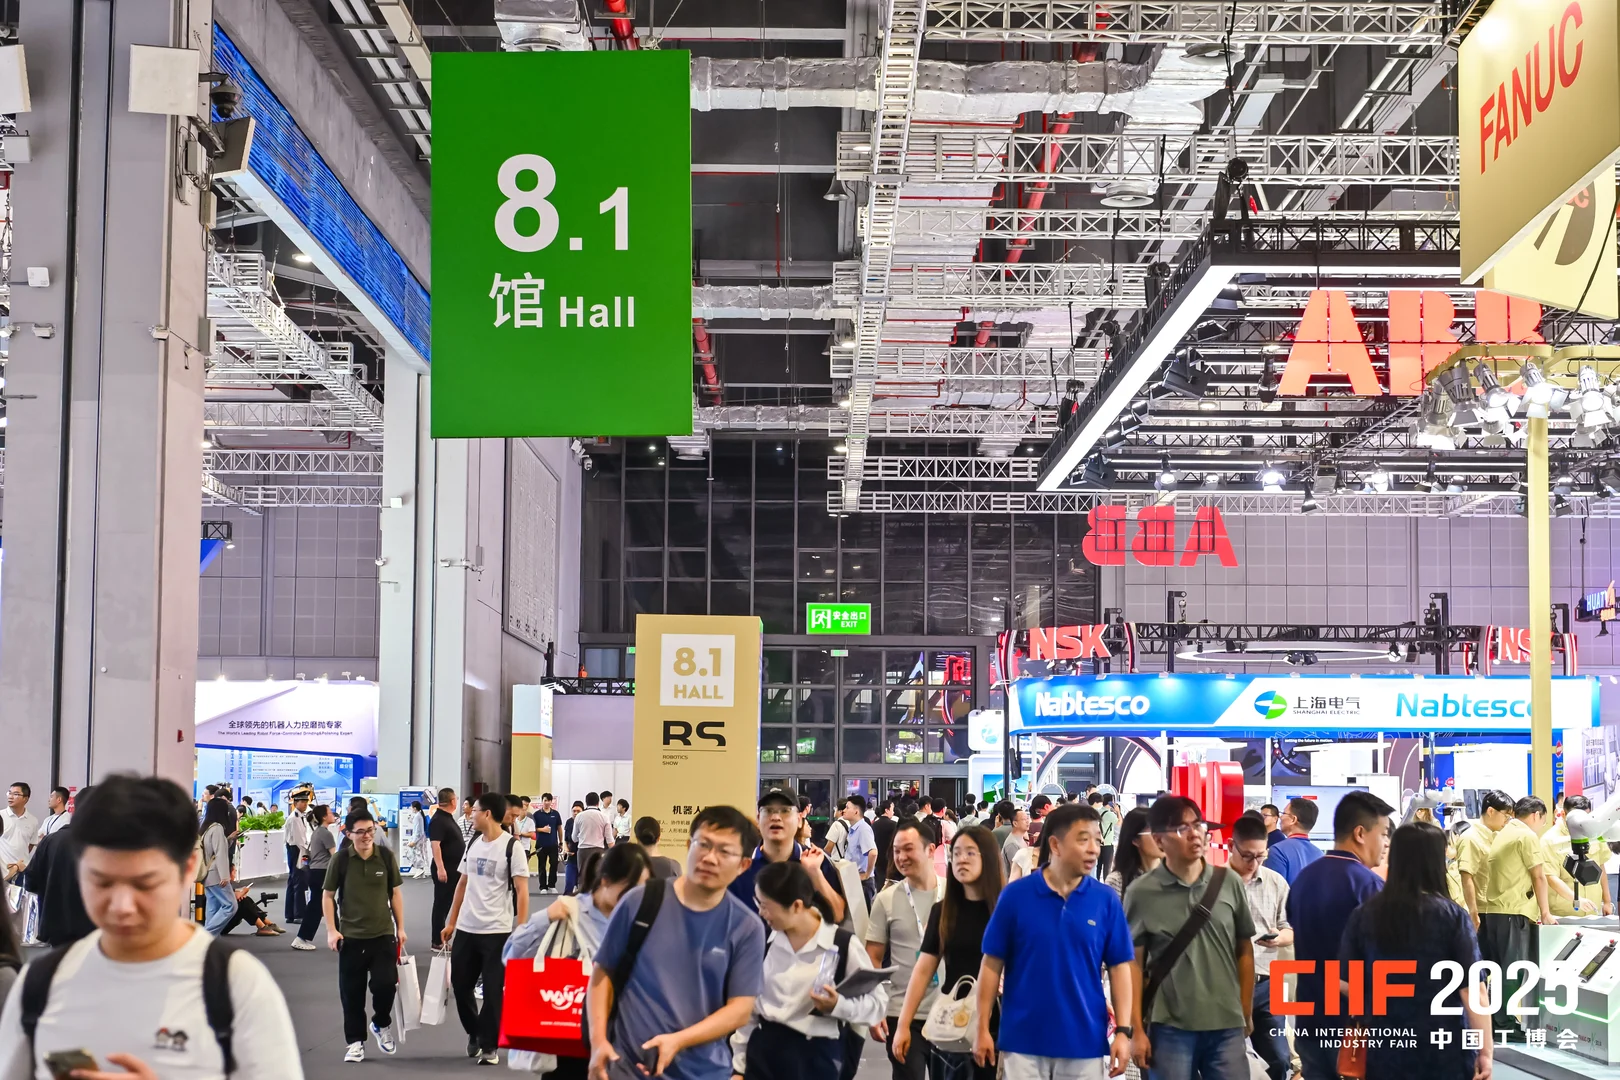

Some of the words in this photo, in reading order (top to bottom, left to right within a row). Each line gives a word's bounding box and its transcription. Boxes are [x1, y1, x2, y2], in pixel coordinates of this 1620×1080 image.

[1480, 1, 1584, 175] FANUC
[494, 153, 629, 253] 8.1
[488, 272, 545, 328] 馆
[559, 296, 635, 328] Hall
[832, 610, 867, 621] 安全出口
[840, 620, 858, 628] EXIT
[1029, 623, 1113, 660] NSK
[673, 647, 722, 677] 8.1
[673, 684, 724, 699] HALL
[1035, 690, 1150, 717] Nabtesco
[1293, 696, 1360, 709] 上海电气
[1395, 692, 1531, 718] Nabtesc
[228, 720, 343, 729] 全球领先的机器人力控磨抛专家
[662, 720, 727, 747] RS
[673, 805, 709, 815] 机器人
